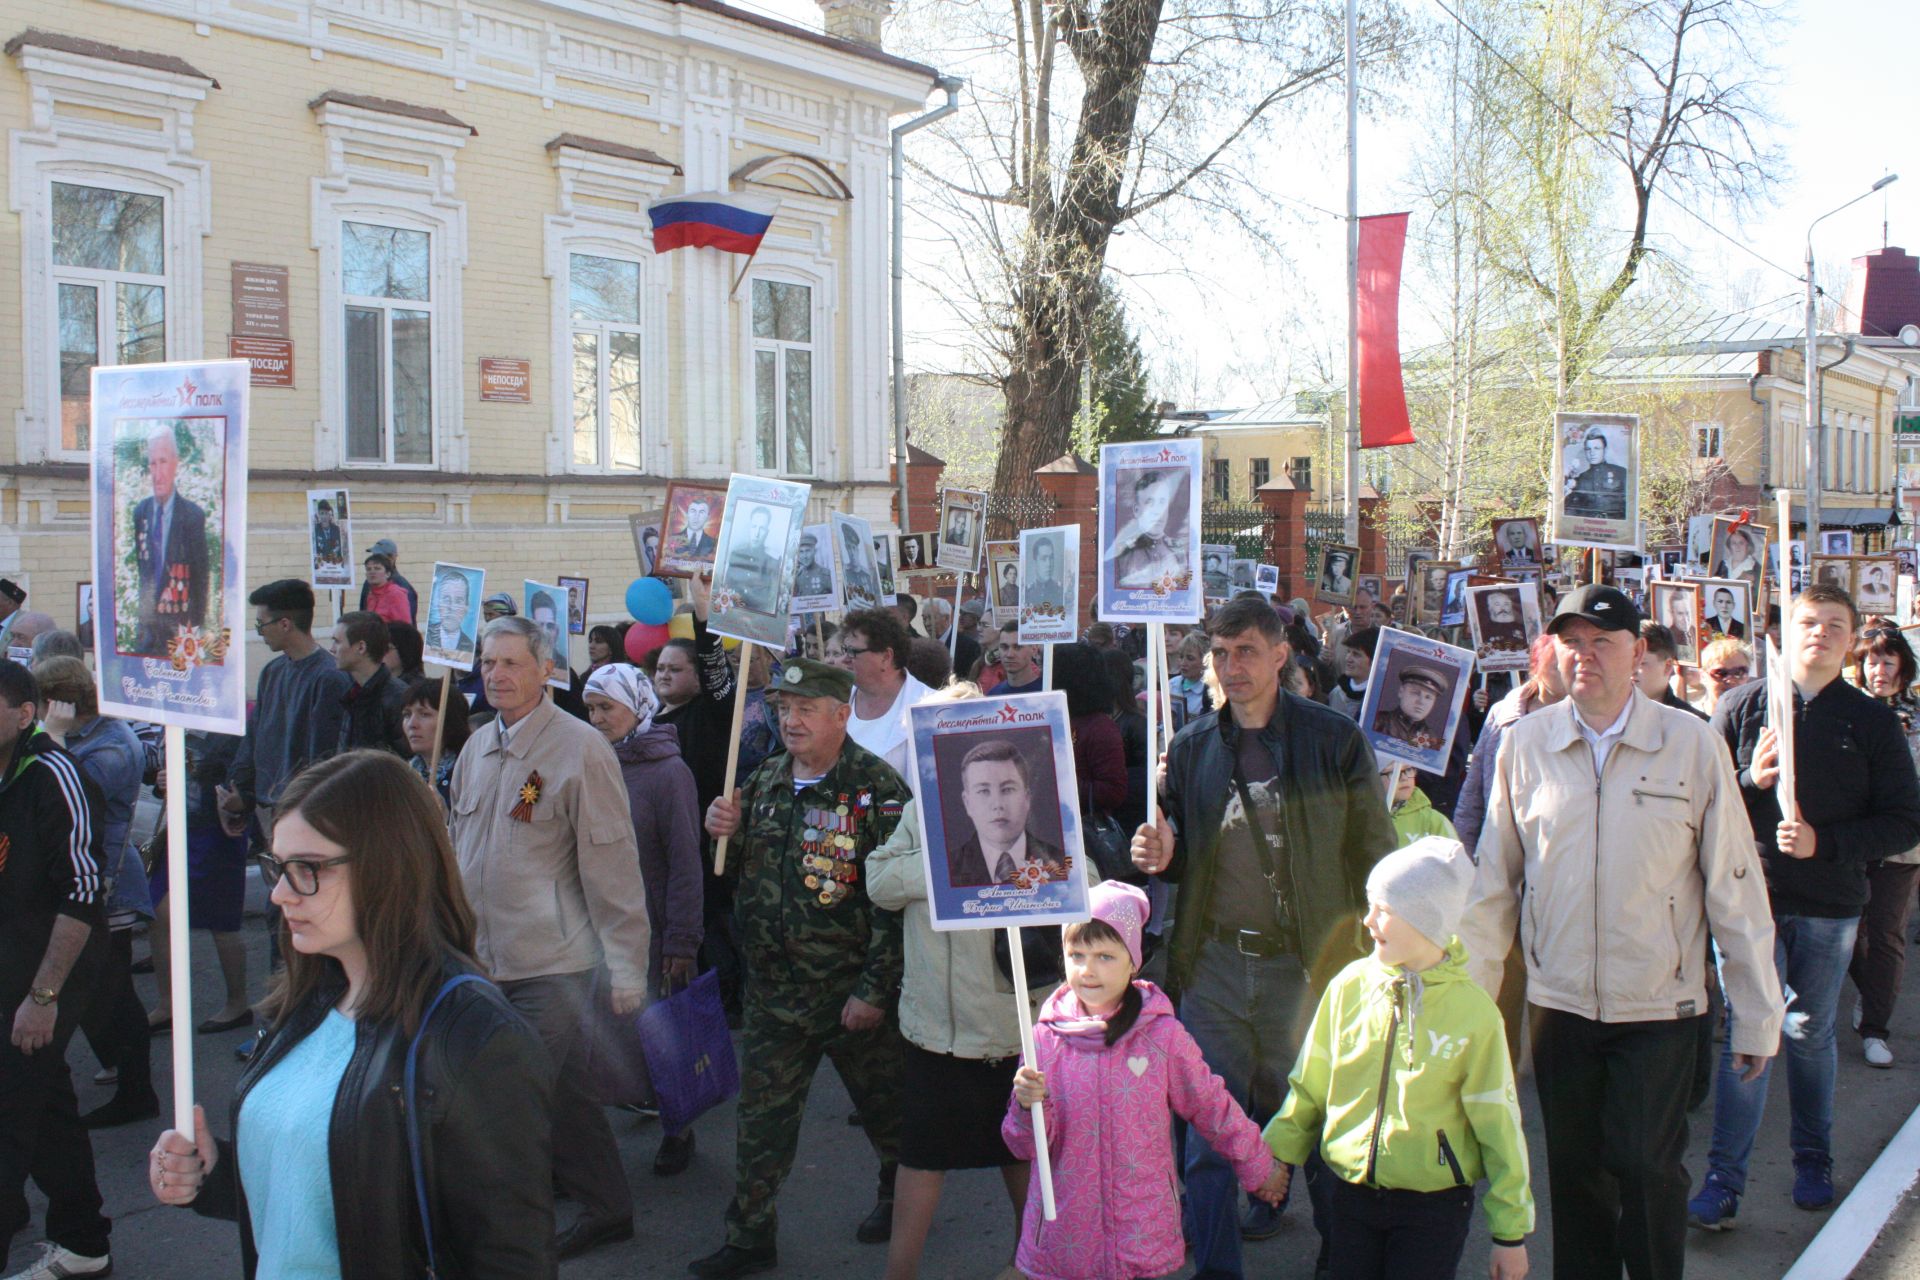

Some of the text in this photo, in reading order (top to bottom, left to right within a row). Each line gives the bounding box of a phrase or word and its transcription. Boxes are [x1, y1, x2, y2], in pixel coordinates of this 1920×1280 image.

[249, 357, 289, 372] ПОСЕДА"
[195, 393, 223, 407] ПОЛК
[1018, 711, 1045, 722] ПОЛК
[978, 884, 1039, 899] Антонов
[963, 897, 1062, 916] Борис Иванович
